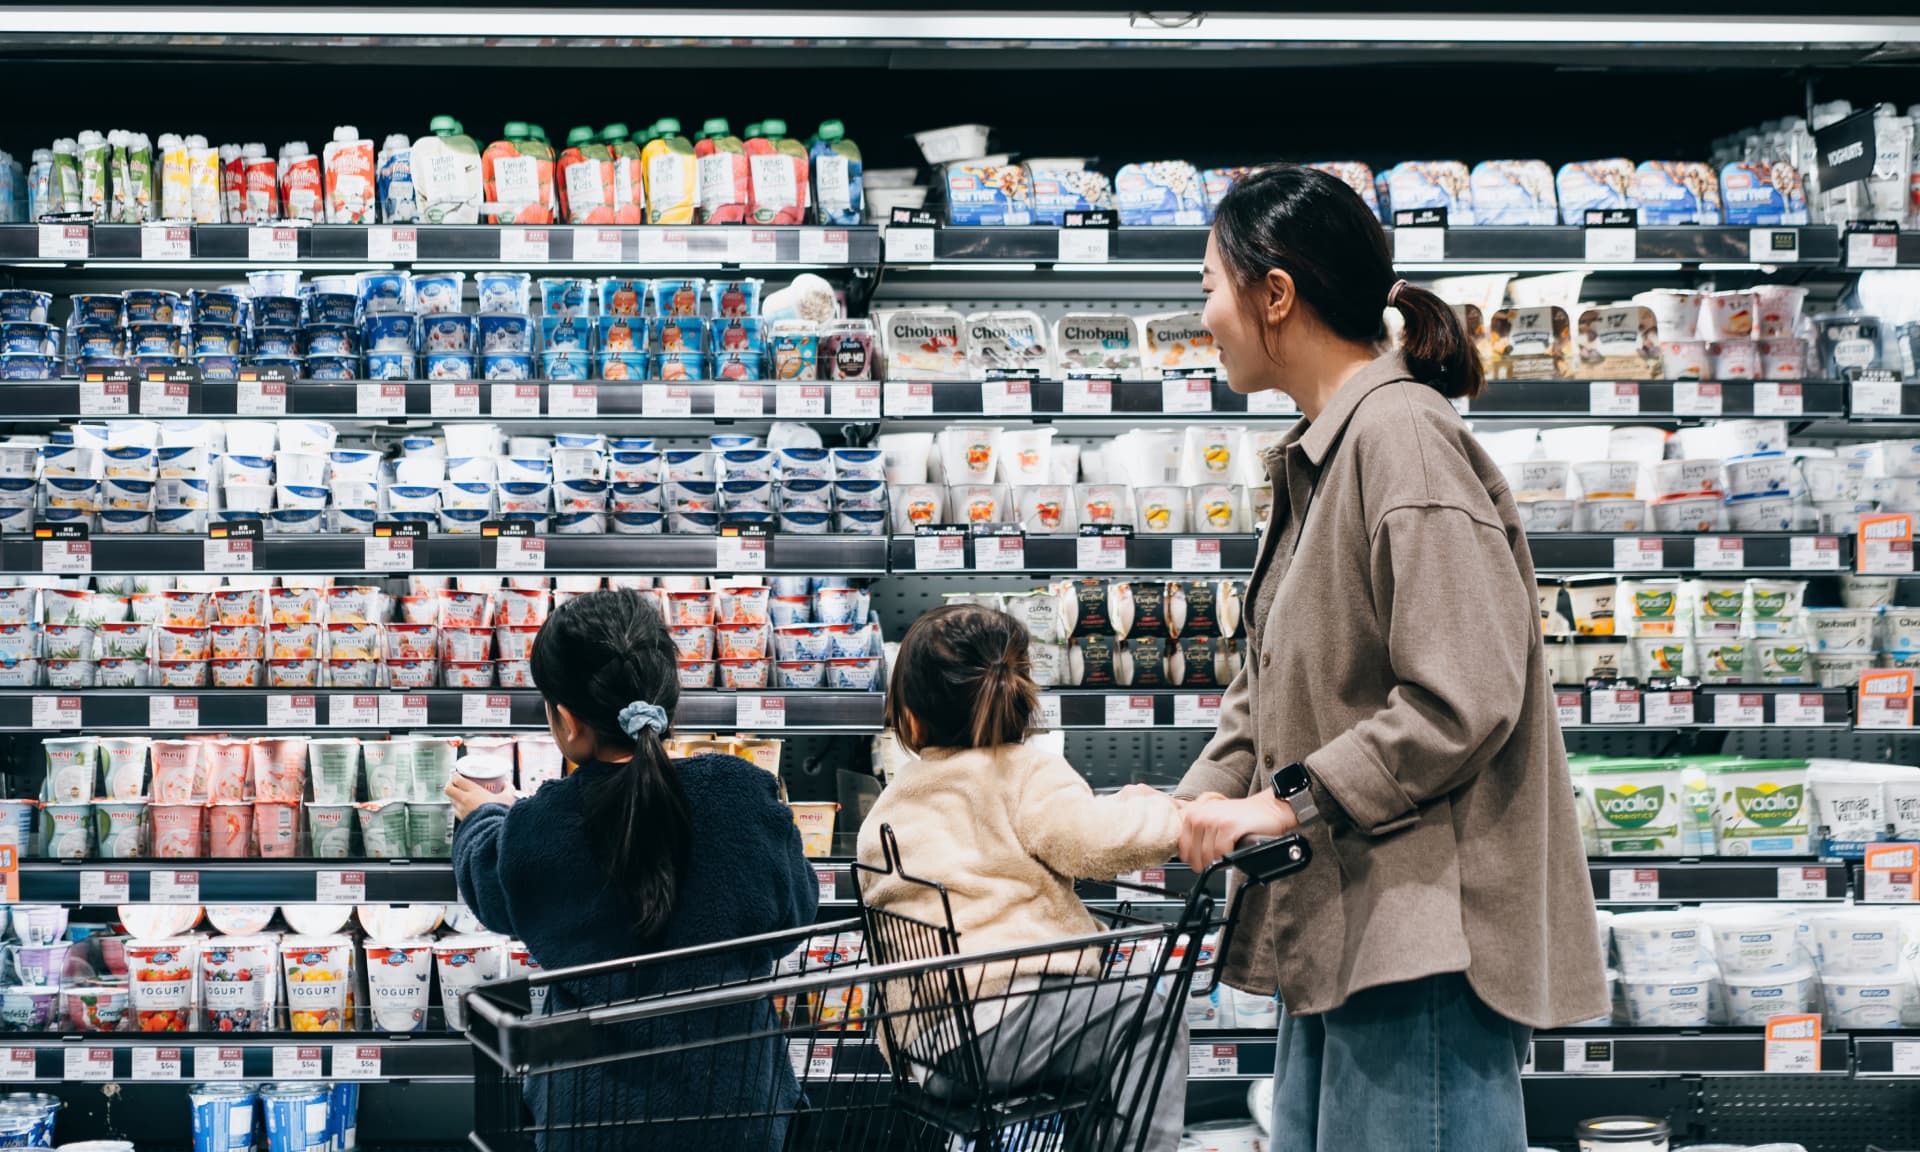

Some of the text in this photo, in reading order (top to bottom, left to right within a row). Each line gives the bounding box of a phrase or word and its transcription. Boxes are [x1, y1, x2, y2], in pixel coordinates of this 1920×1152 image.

[1827, 140, 1863, 168] YOGHURTS
[894, 324, 957, 339] Chobani
[1064, 326, 1129, 341] Chobani
[838, 352, 865, 364] POP-MIX
[50, 750, 73, 759] meiji
[110, 748, 133, 757] meiji
[159, 750, 185, 760] meiji
[215, 749, 238, 758] meiji
[1600, 794, 1659, 813] vaalia
[1741, 792, 1799, 812] vaalia
[54, 812, 79, 822] meiji
[110, 811, 136, 821] meiji
[156, 813, 180, 822] meiji
[317, 812, 341, 822] meiji
[799, 812, 823, 822] meiji
[1609, 812, 1654, 820] PROBIOTICS
[1751, 811, 1793, 819] PROBIOTICS
[141, 985, 186, 996] YOGURT
[292, 986, 337, 997] YOGURT
[376, 987, 421, 998] YOGURT
